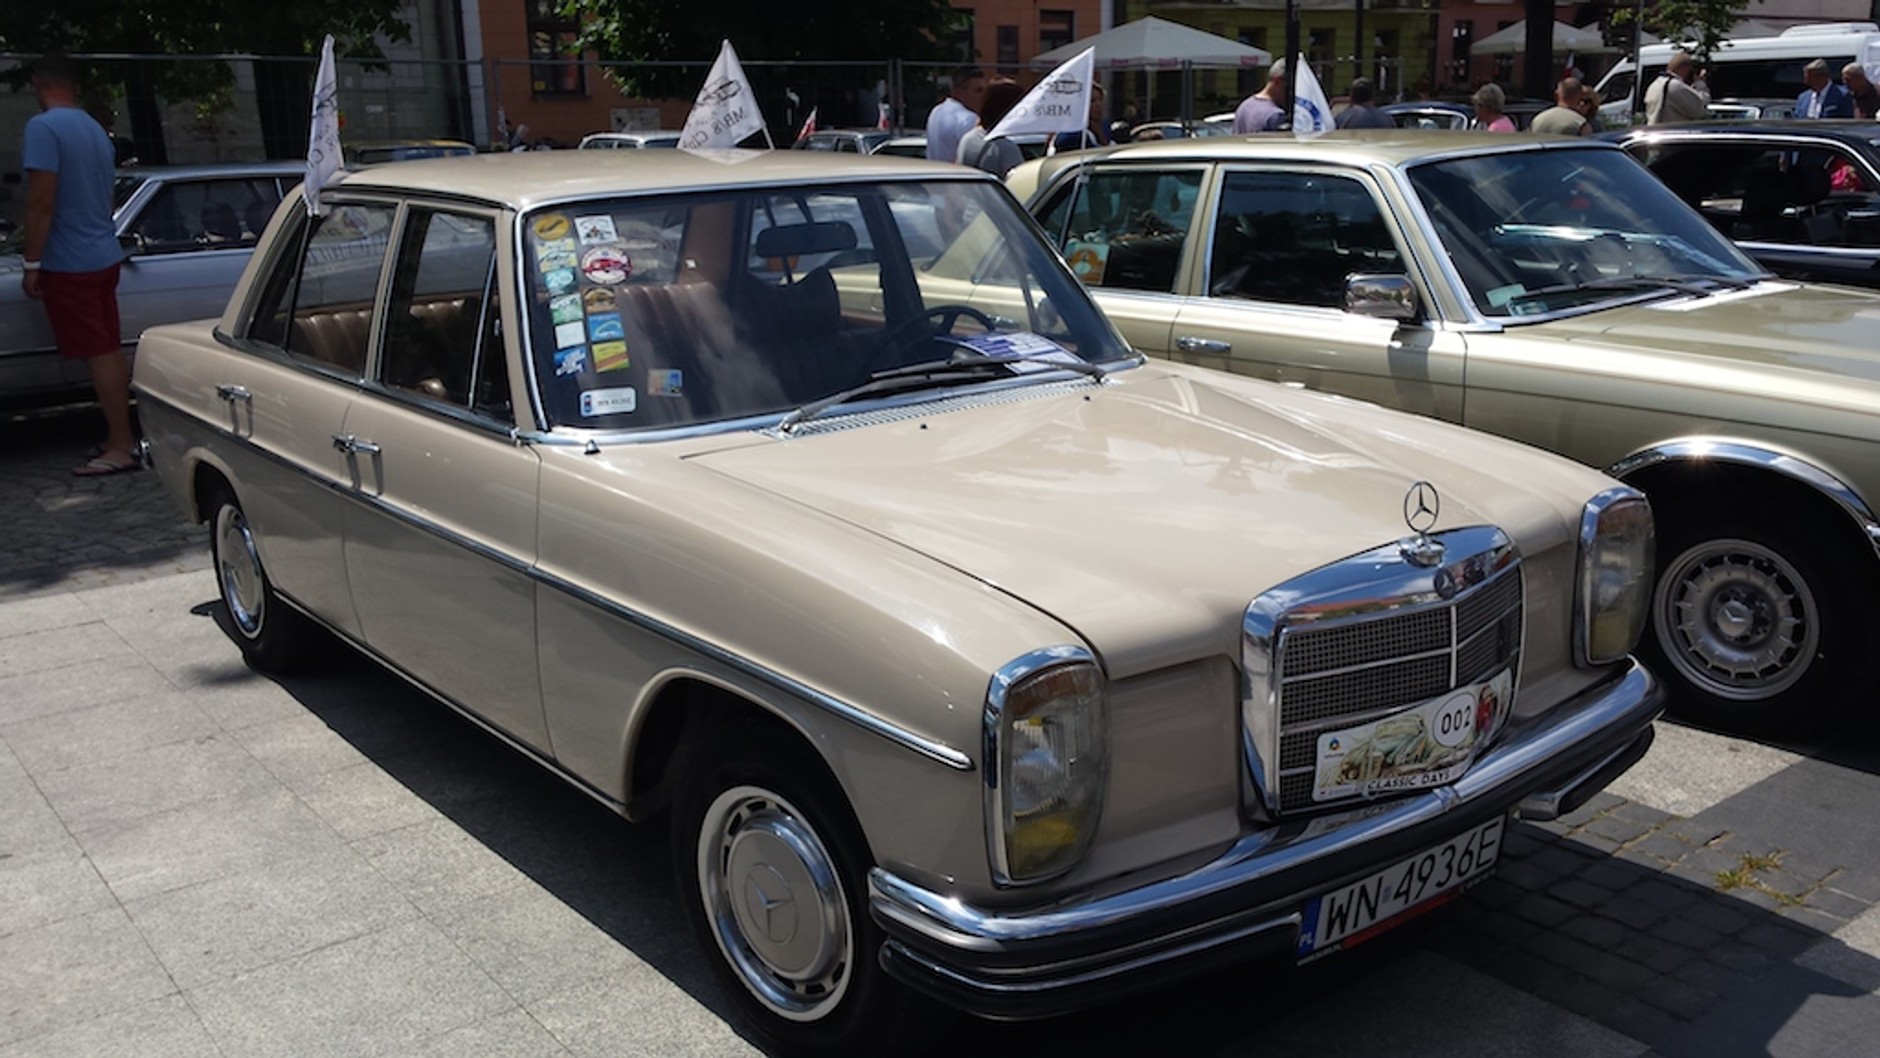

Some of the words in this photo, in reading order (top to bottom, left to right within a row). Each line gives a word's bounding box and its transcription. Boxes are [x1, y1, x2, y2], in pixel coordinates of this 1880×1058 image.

[1441, 706, 1472, 735] 002
[1367, 775, 1417, 790] CLASSIC
[1421, 770, 1450, 785] DAYS
[1325, 875, 1384, 940] WN
[1393, 822, 1498, 904] 4936E
